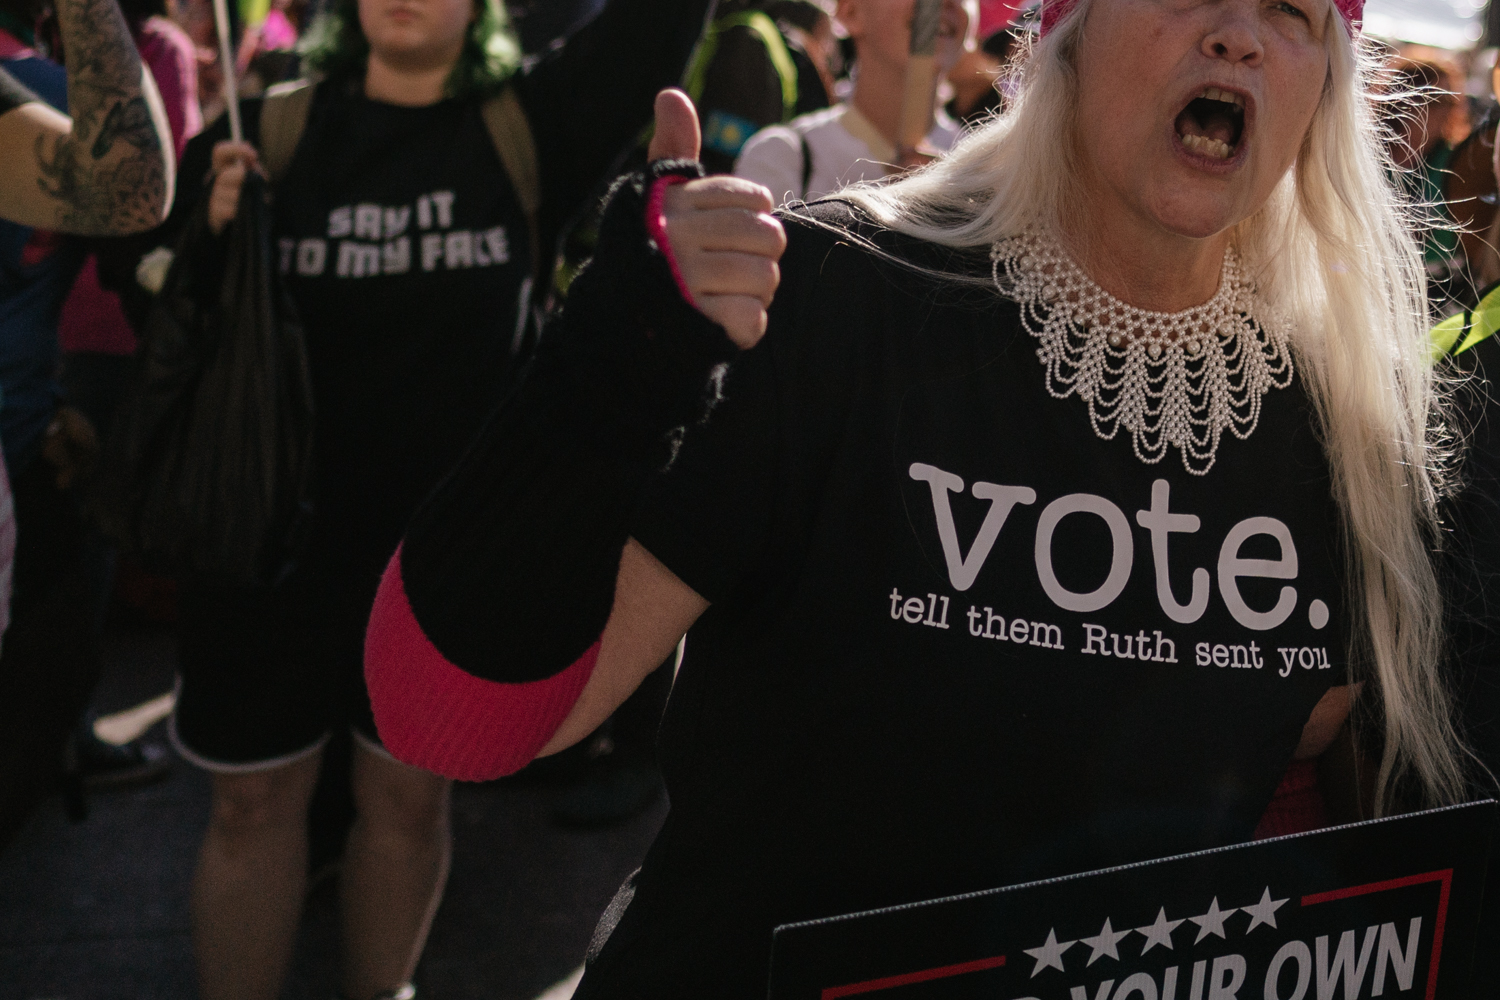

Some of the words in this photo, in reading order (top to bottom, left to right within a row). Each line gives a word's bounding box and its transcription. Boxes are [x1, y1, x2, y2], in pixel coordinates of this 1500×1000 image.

[328, 203, 411, 240] SAY
[416, 189, 455, 230] IT
[908, 462, 1330, 631] vote.
[889, 587, 950, 629] tell
[966, 605, 1065, 650] them
[1081, 622, 1179, 664] Ruth
[1196, 640, 1264, 669] sent
[1277, 641, 1331, 678] you
[1263, 915, 1423, 1000] OWN
